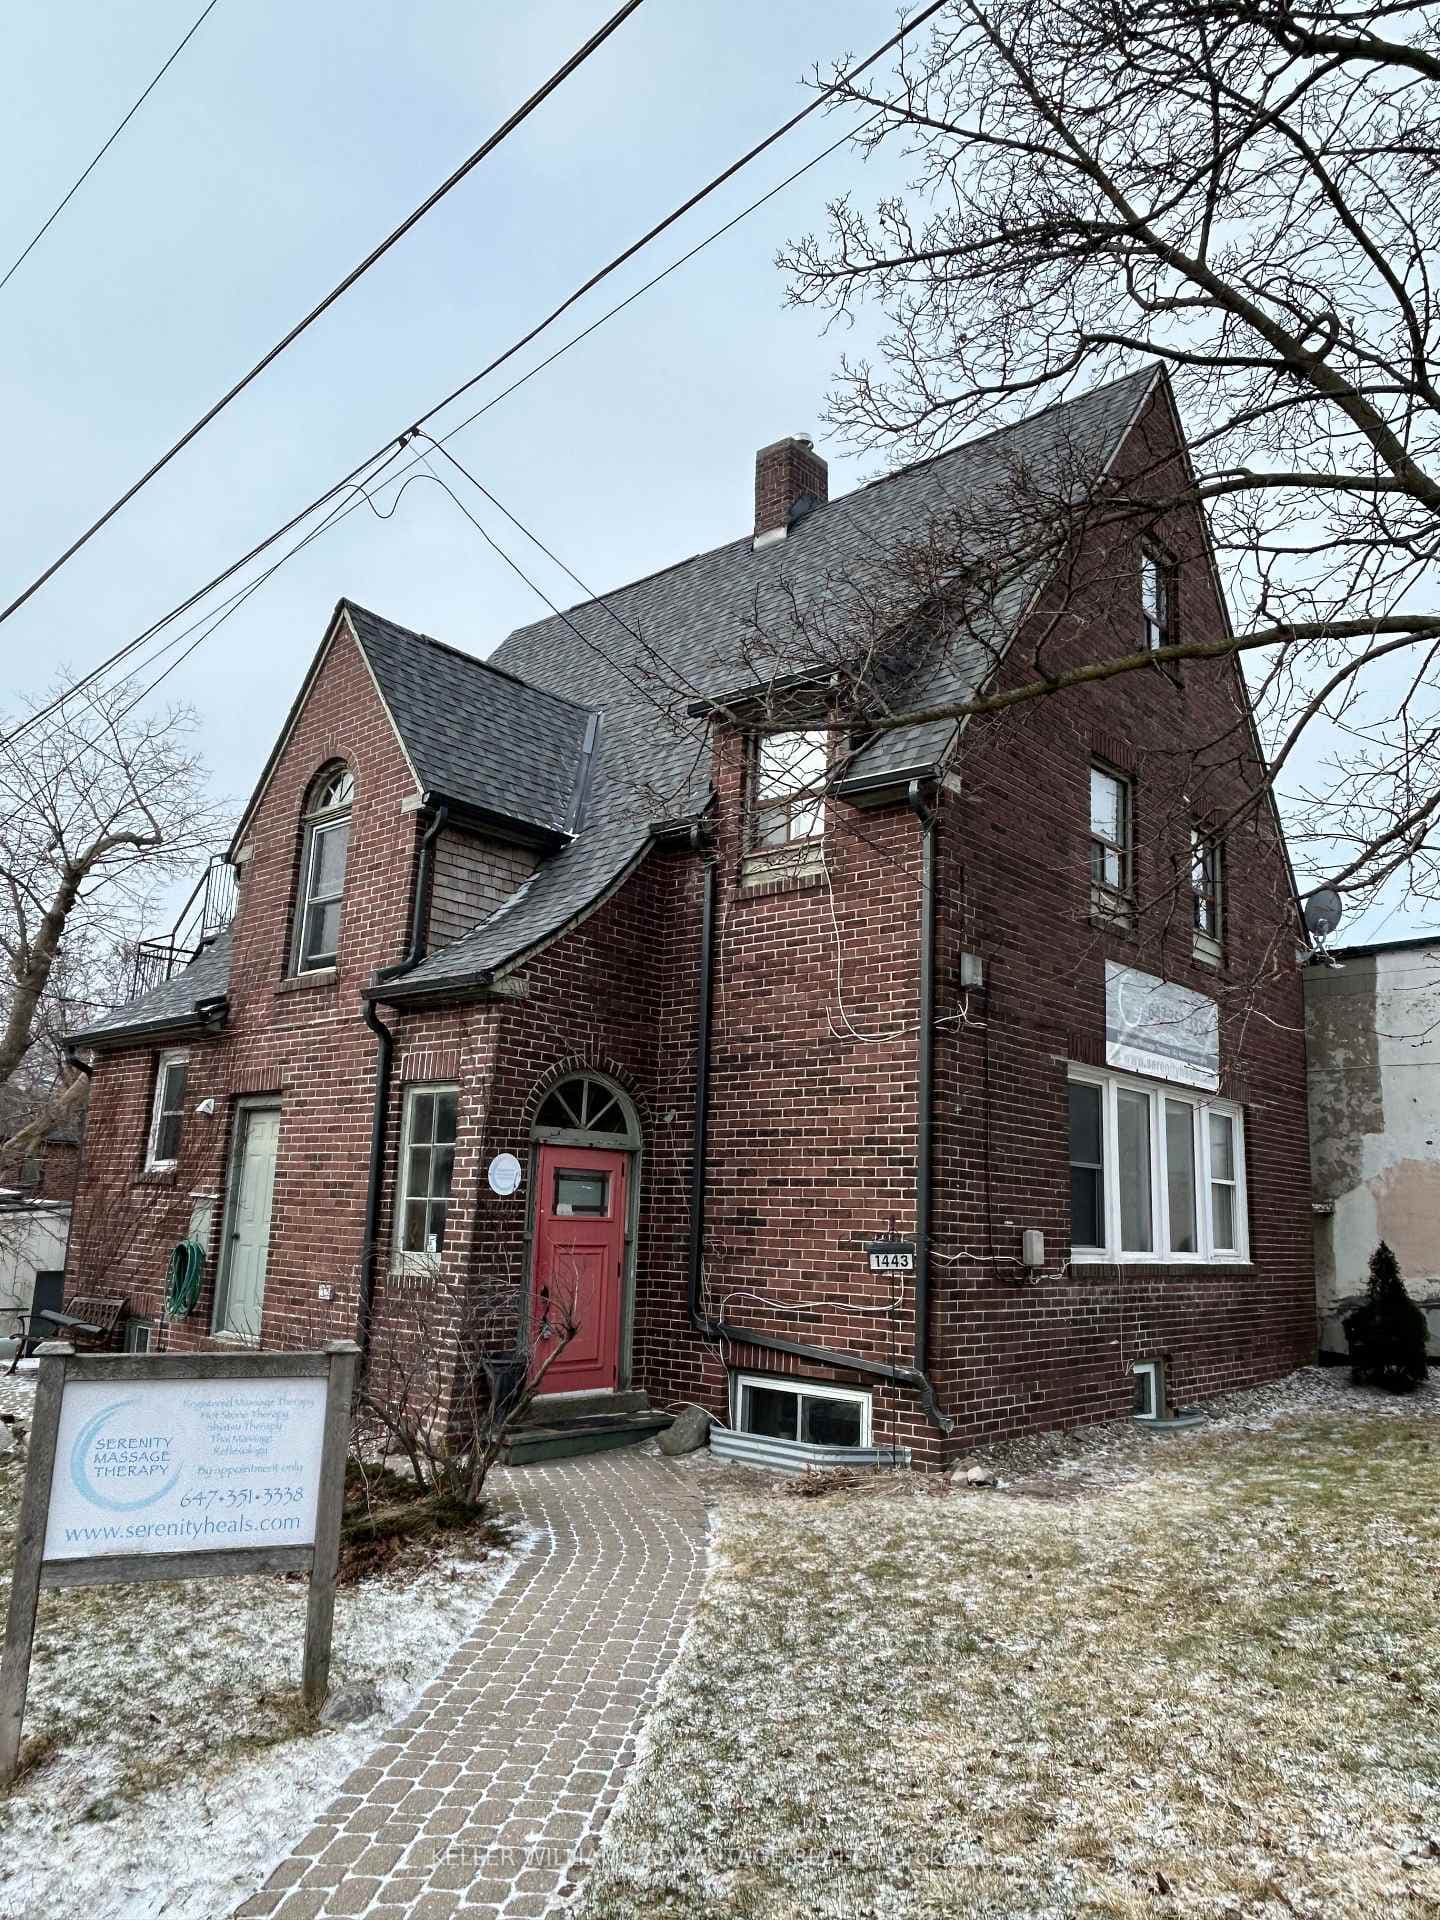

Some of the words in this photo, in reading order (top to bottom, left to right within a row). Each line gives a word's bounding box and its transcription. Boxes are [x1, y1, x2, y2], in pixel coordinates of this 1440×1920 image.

[874, 1254, 909, 1268] 1443
[95, 1436, 174, 1451] SERENITY
[92, 1450, 171, 1465] MASSAGE
[93, 1463, 169, 1478] THERAPY
[64, 1513, 301, 1541] www.serenityheals.com
